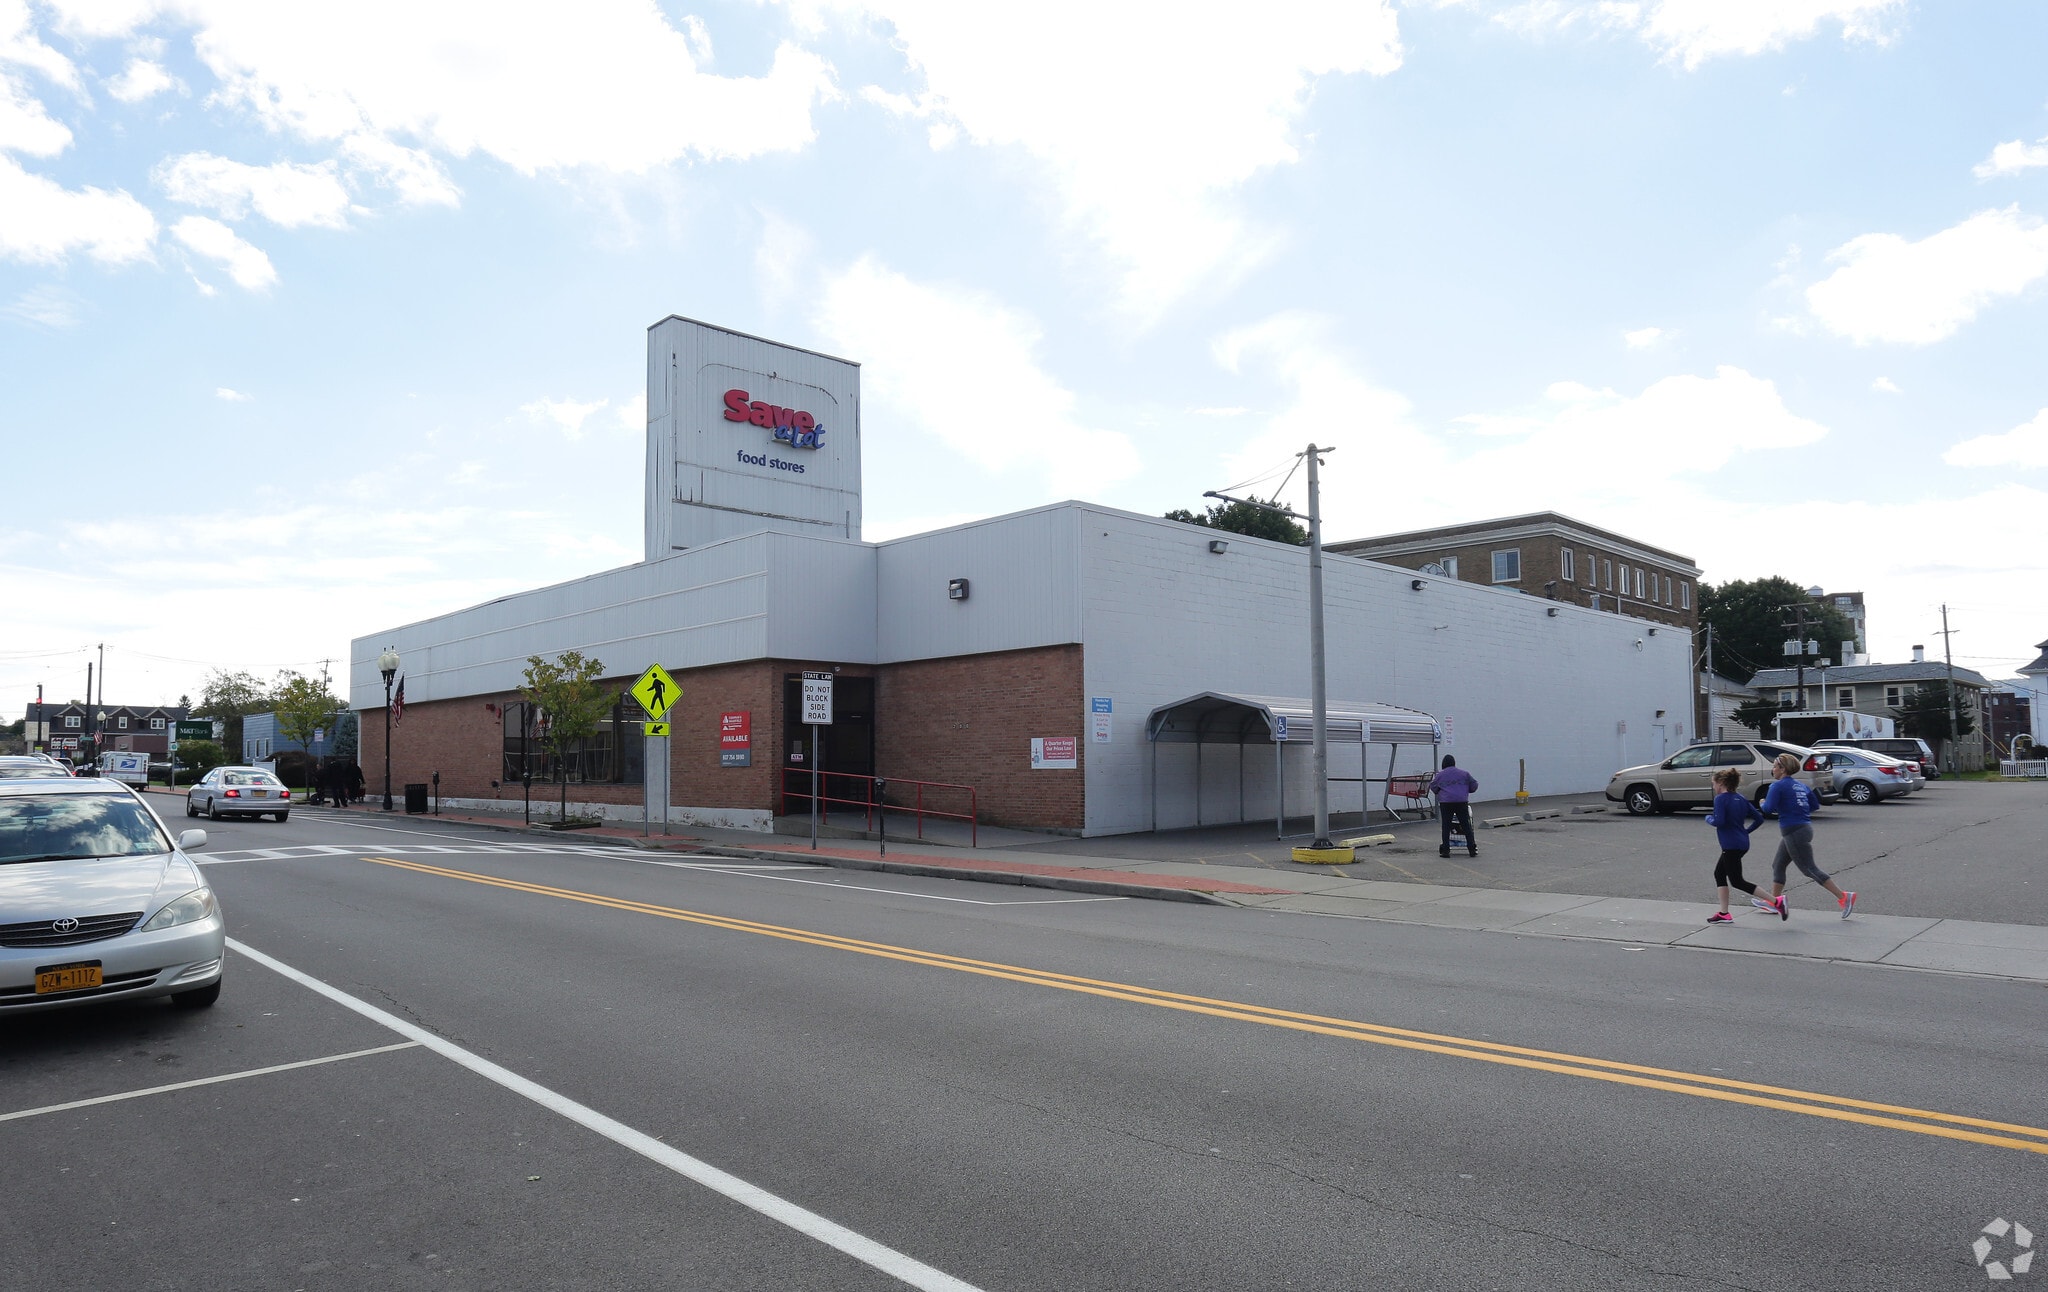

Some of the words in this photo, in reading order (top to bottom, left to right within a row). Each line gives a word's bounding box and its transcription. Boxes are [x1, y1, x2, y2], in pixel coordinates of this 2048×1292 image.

[723, 389, 815, 434] Save
[737, 449, 767, 467] food
[769, 457, 805, 474] stores
